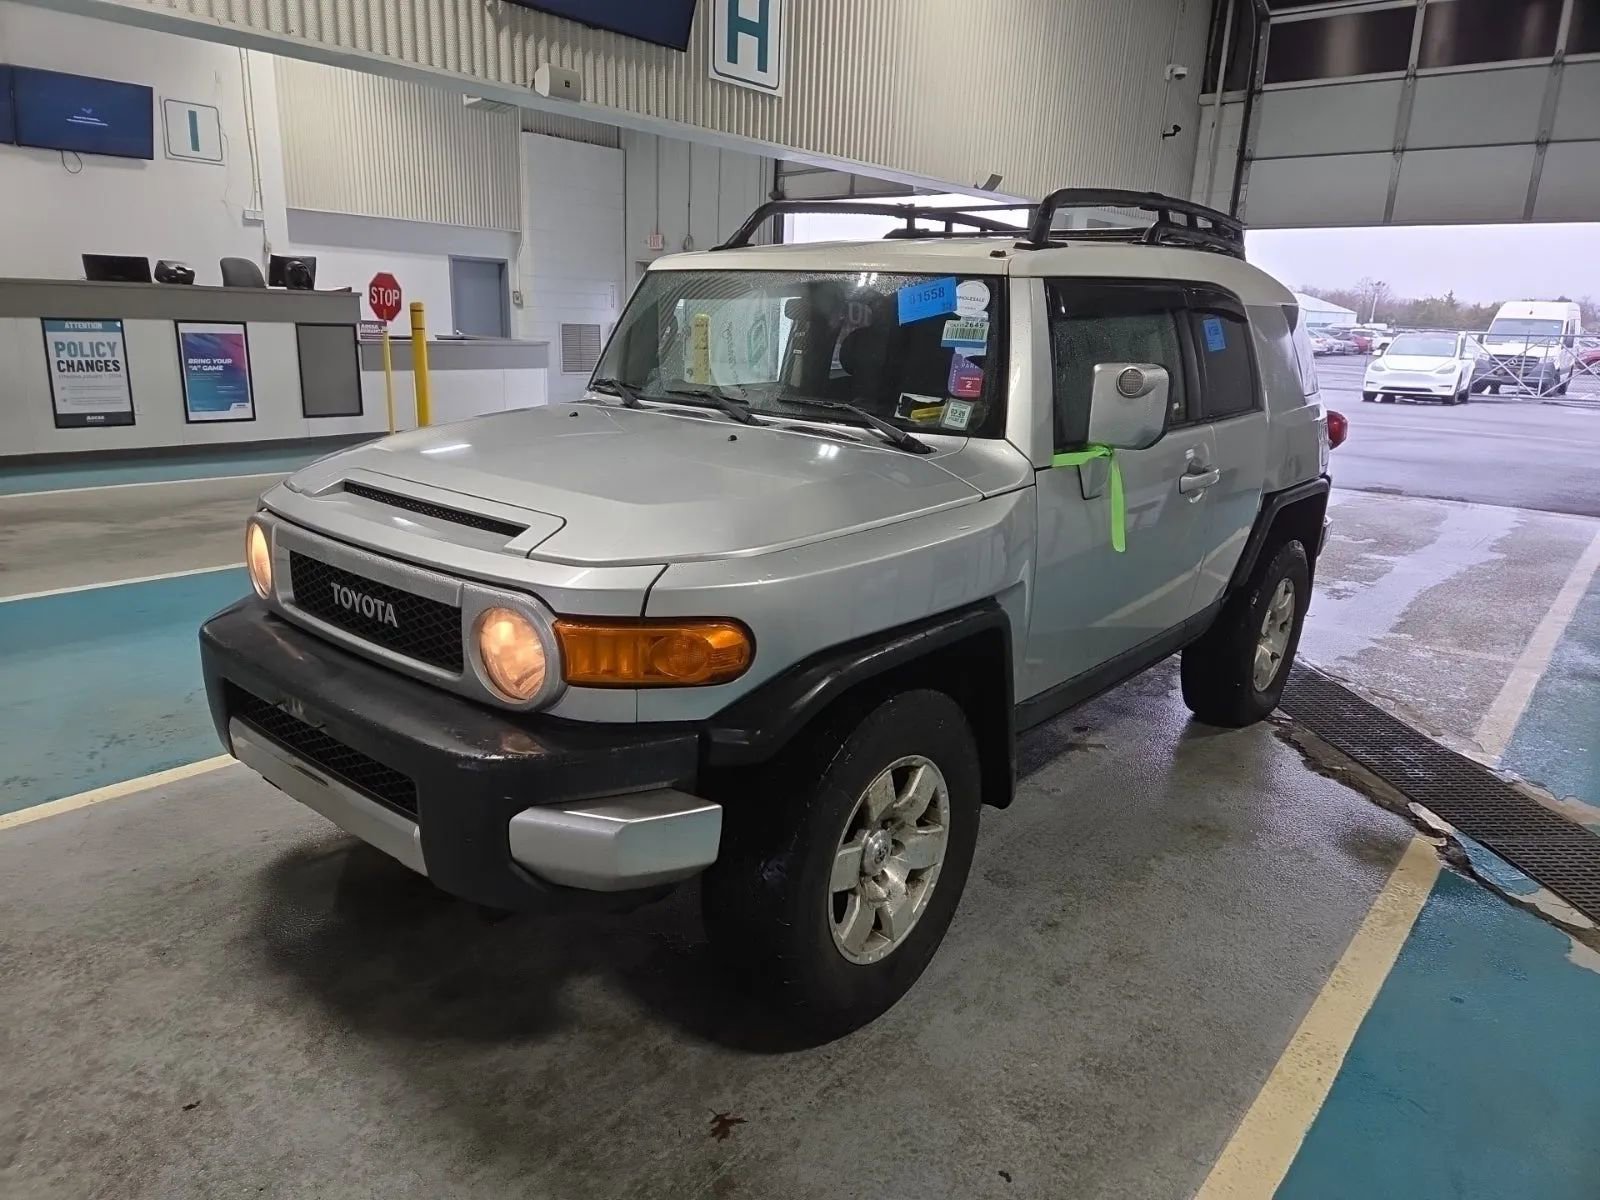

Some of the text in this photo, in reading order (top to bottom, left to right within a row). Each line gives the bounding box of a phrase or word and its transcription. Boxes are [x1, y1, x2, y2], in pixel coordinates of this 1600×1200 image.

[727, 0, 769, 73] H
[188, 110, 200, 153] I
[371, 287, 400, 307] STOP
[64, 321, 103, 329] ATTENTION
[54, 341, 117, 358] POLICY
[57, 359, 121, 373] CHANGES
[965, 381, 973, 389] 2
[331, 582, 398, 628] TOYOTA
